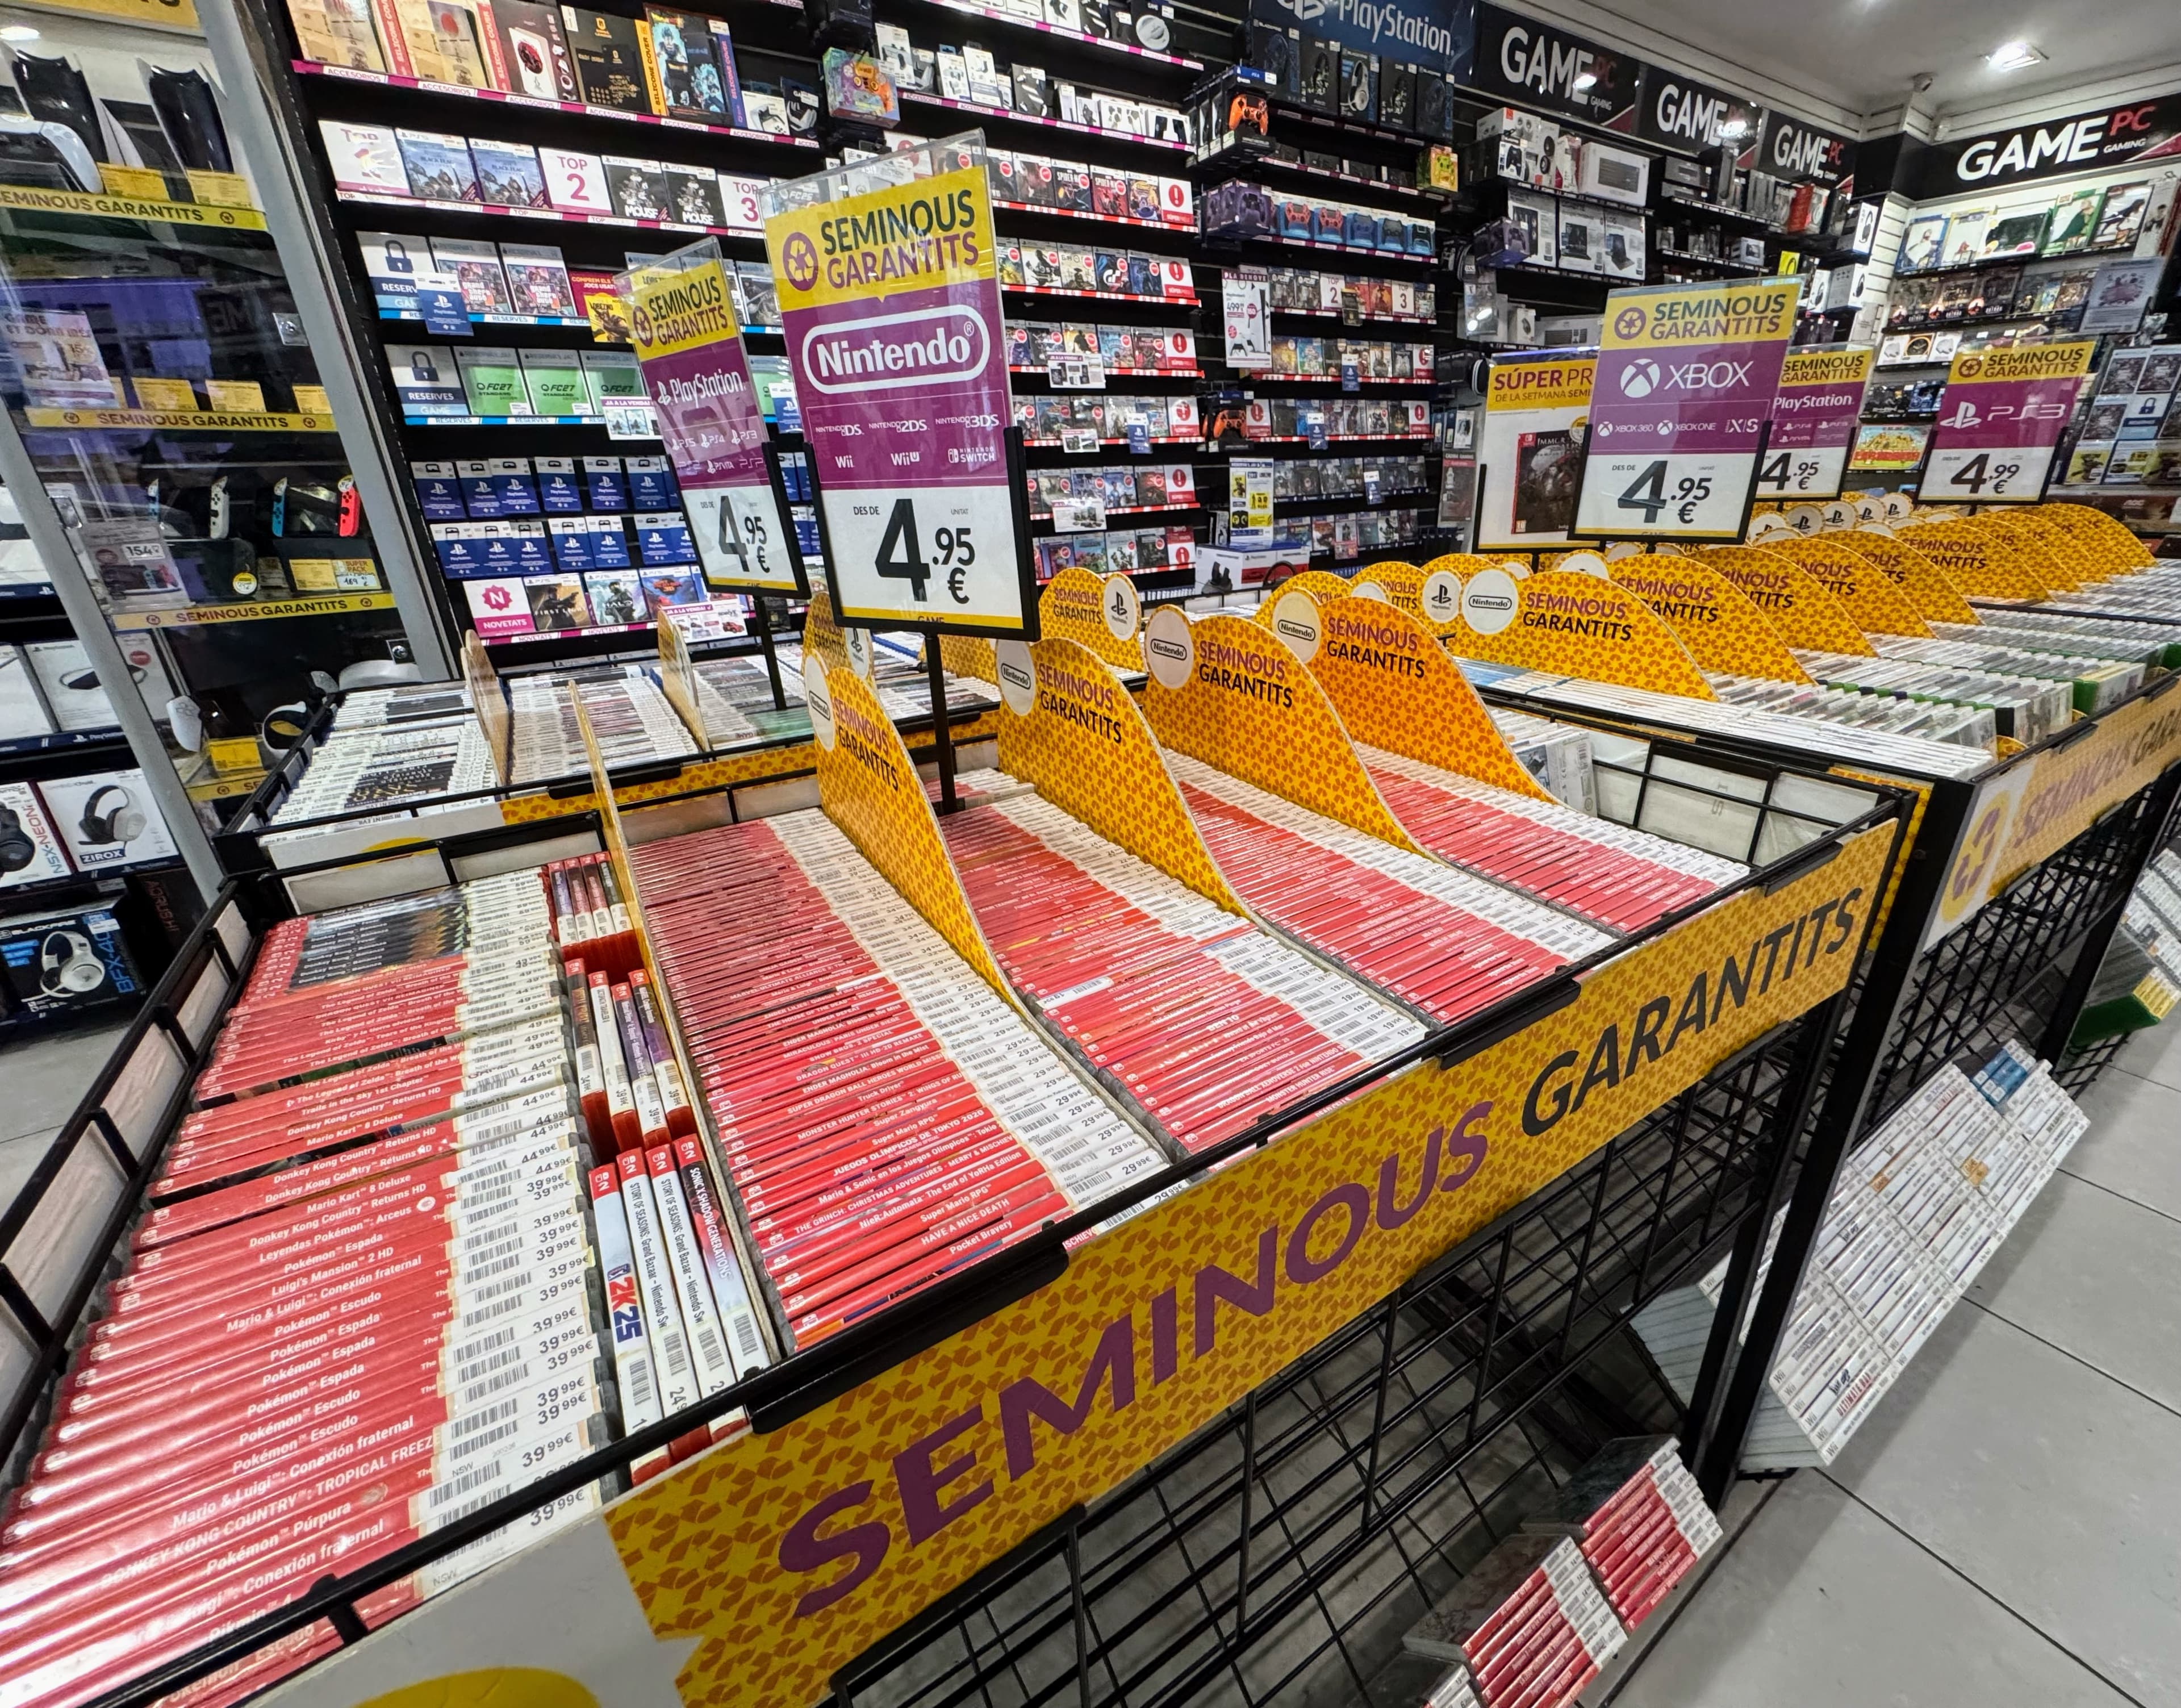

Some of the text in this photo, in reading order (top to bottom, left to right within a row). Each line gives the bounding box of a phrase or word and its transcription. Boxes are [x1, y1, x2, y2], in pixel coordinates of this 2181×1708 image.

[1339, 0, 1453, 56] PlayStation
[643, 36, 656, 65] COVER
[328, 68, 381, 83] ACCESORIOS
[1502, 27, 1616, 103] GAME PC
[422, 83, 471, 95] ACCESORIOS
[1657, 84, 1729, 147] GAME
[1774, 125, 1844, 178] GAME PC
[1957, 106, 2156, 181] GAME PC
[2104, 139, 2146, 154] GAMING
[557, 156, 587, 170] TOP
[567, 173, 590, 201] 2
[733, 182, 758, 194] TOP
[0, 191, 203, 222] EMINOUS GARANTITS
[625, 204, 658, 219] MOUSE
[682, 211, 714, 225] MOUSE
[741, 198, 759, 222] 3
[821, 189, 976, 256] SEMINOUS
[827, 231, 979, 290] GARANTITS
[382, 283, 418, 293] RESERV
[649, 276, 721, 321] SEMINOUS
[1330, 287, 1338, 304] 2
[1400, 294, 1407, 309] 3
[1654, 294, 1786, 321] SEMINOUS
[657, 305, 728, 345] GARANTITS
[1650, 315, 1781, 340] GARANTITS
[1783, 354, 1864, 371] SEMINOUS
[1984, 361, 2079, 378] GARANTITS
[1987, 349, 2084, 366] SEMINOUS
[1494, 368, 1562, 390] SÚPER
[1664, 361, 1754, 390] XBOX
[1781, 368, 1861, 383] GARANTITS
[408, 392, 453, 400] RESERVES
[670, 369, 743, 408] PlayStation
[1522, 391, 1566, 400] SETMANA
[1568, 389, 1591, 398] SEMI
[1773, 393, 1852, 411] PlayStation
[1987, 404, 2066, 421] PS3
[98, 414, 289, 428] SEMINOUS GARANTITS
[739, 430, 758, 440] PS3
[739, 458, 763, 469] PSP
[835, 455, 854, 468] Wii
[960, 452, 996, 462] SWITCH
[1950, 454, 1990, 494] 4
[1994, 479, 2006, 494] €
[1617, 460, 1668, 524] 4
[1677, 501, 1698, 524] €
[853, 506, 880, 516] DES DE
[718, 495, 750, 572] 4
[875, 498, 931, 603] 4
[947, 567, 970, 604] €
[1054, 588, 1100, 607] SEMINOUS
[1472, 597, 1510, 608] Nintendo
[1526, 592, 1627, 620] SEMINOUS
[177, 600, 347, 623] SEMINOUS GARANTITS
[1052, 603, 1102, 625] GARANTITS
[1647, 598, 1718, 623] ANTITS
[483, 619, 527, 630] NOVETATS
[1280, 623, 1314, 639] Nintendo
[1327, 617, 1418, 652] SEMINOUS
[1523, 612, 1633, 641] GARANTITS
[518, 633, 553, 642] NOVETATS
[1152, 641, 1186, 658] Nintendo
[1199, 640, 1286, 681] SEMINOUS
[1327, 640, 1425, 678] GARANTITS
[1002, 667, 1030, 687] Nintendo
[1038, 663, 1114, 711] SEMINOUS
[1198, 663, 1293, 708] GARANTITS
[834, 698, 889, 757] SEMINOUS
[1040, 692, 1122, 745] GARANTITS
[838, 726, 899, 792] GARANTITS
[82, 850, 124, 863] ZIROX
[287, 1122, 322, 1136] Donkey
[324, 1115, 347, 1127] Kong
[393, 1092, 426, 1105] Returns
[833, 1109, 985, 1177] JUEGOS OLÍMPICOS DE TOKYO 2020
[630, 1183, 642, 1200] STORY
[260, 1241, 312, 1263] Leyendas
[377, 1206, 412, 1223] Arceus
[690, 1167, 704, 1188] SONIC
[697, 1193, 716, 1225] SHADOW
[707, 1224, 732, 1278] GENERATIONS
[921, 1229, 947, 1246] HAVE
[959, 1212, 980, 1227] NICE
[981, 1198, 1010, 1217] DEATH
[642, 1238, 654, 1258] Grand
[949, 1220, 1013, 1254] Pocket Bravery
[774, 885, 1862, 1621] SEMINOUS GARANTITS
[646, 1257, 657, 1280] Bazaar
[320, 1363, 365, 1389] Espada
[316, 1433, 442, 1496] TROPICAL FREEZE
[293, 1503, 351, 1537] Púrpura
